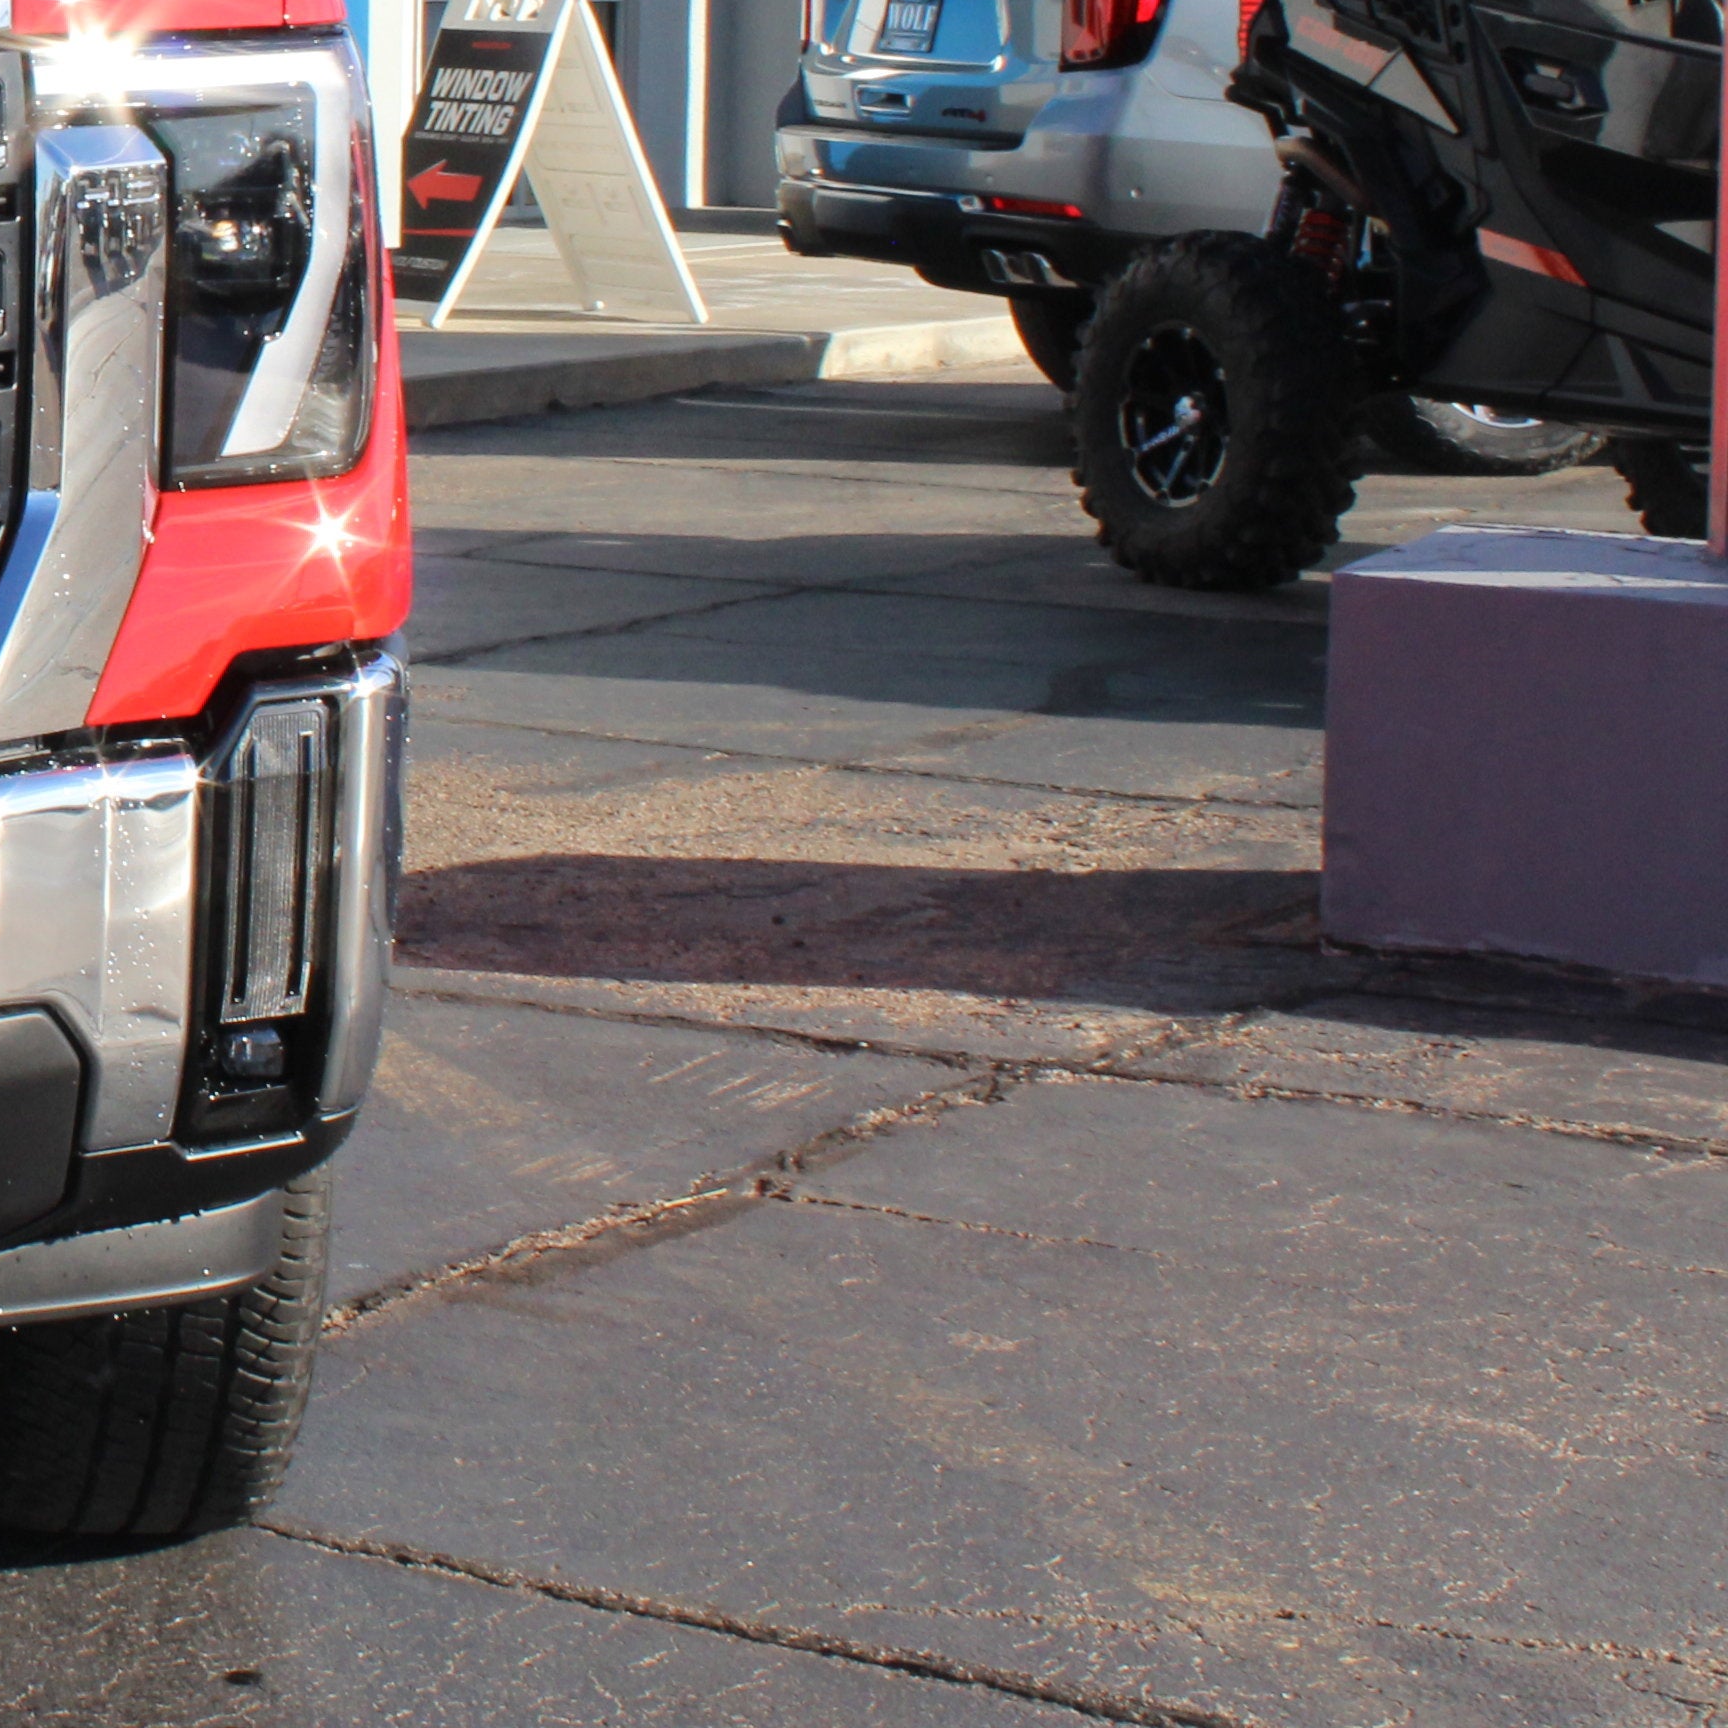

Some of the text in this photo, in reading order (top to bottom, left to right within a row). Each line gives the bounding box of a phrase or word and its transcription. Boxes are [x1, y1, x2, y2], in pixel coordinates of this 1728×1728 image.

[887, 3, 938, 31] WOLF
[431, 68, 533, 102] WINDOW
[424, 100, 516, 136] TINTING
